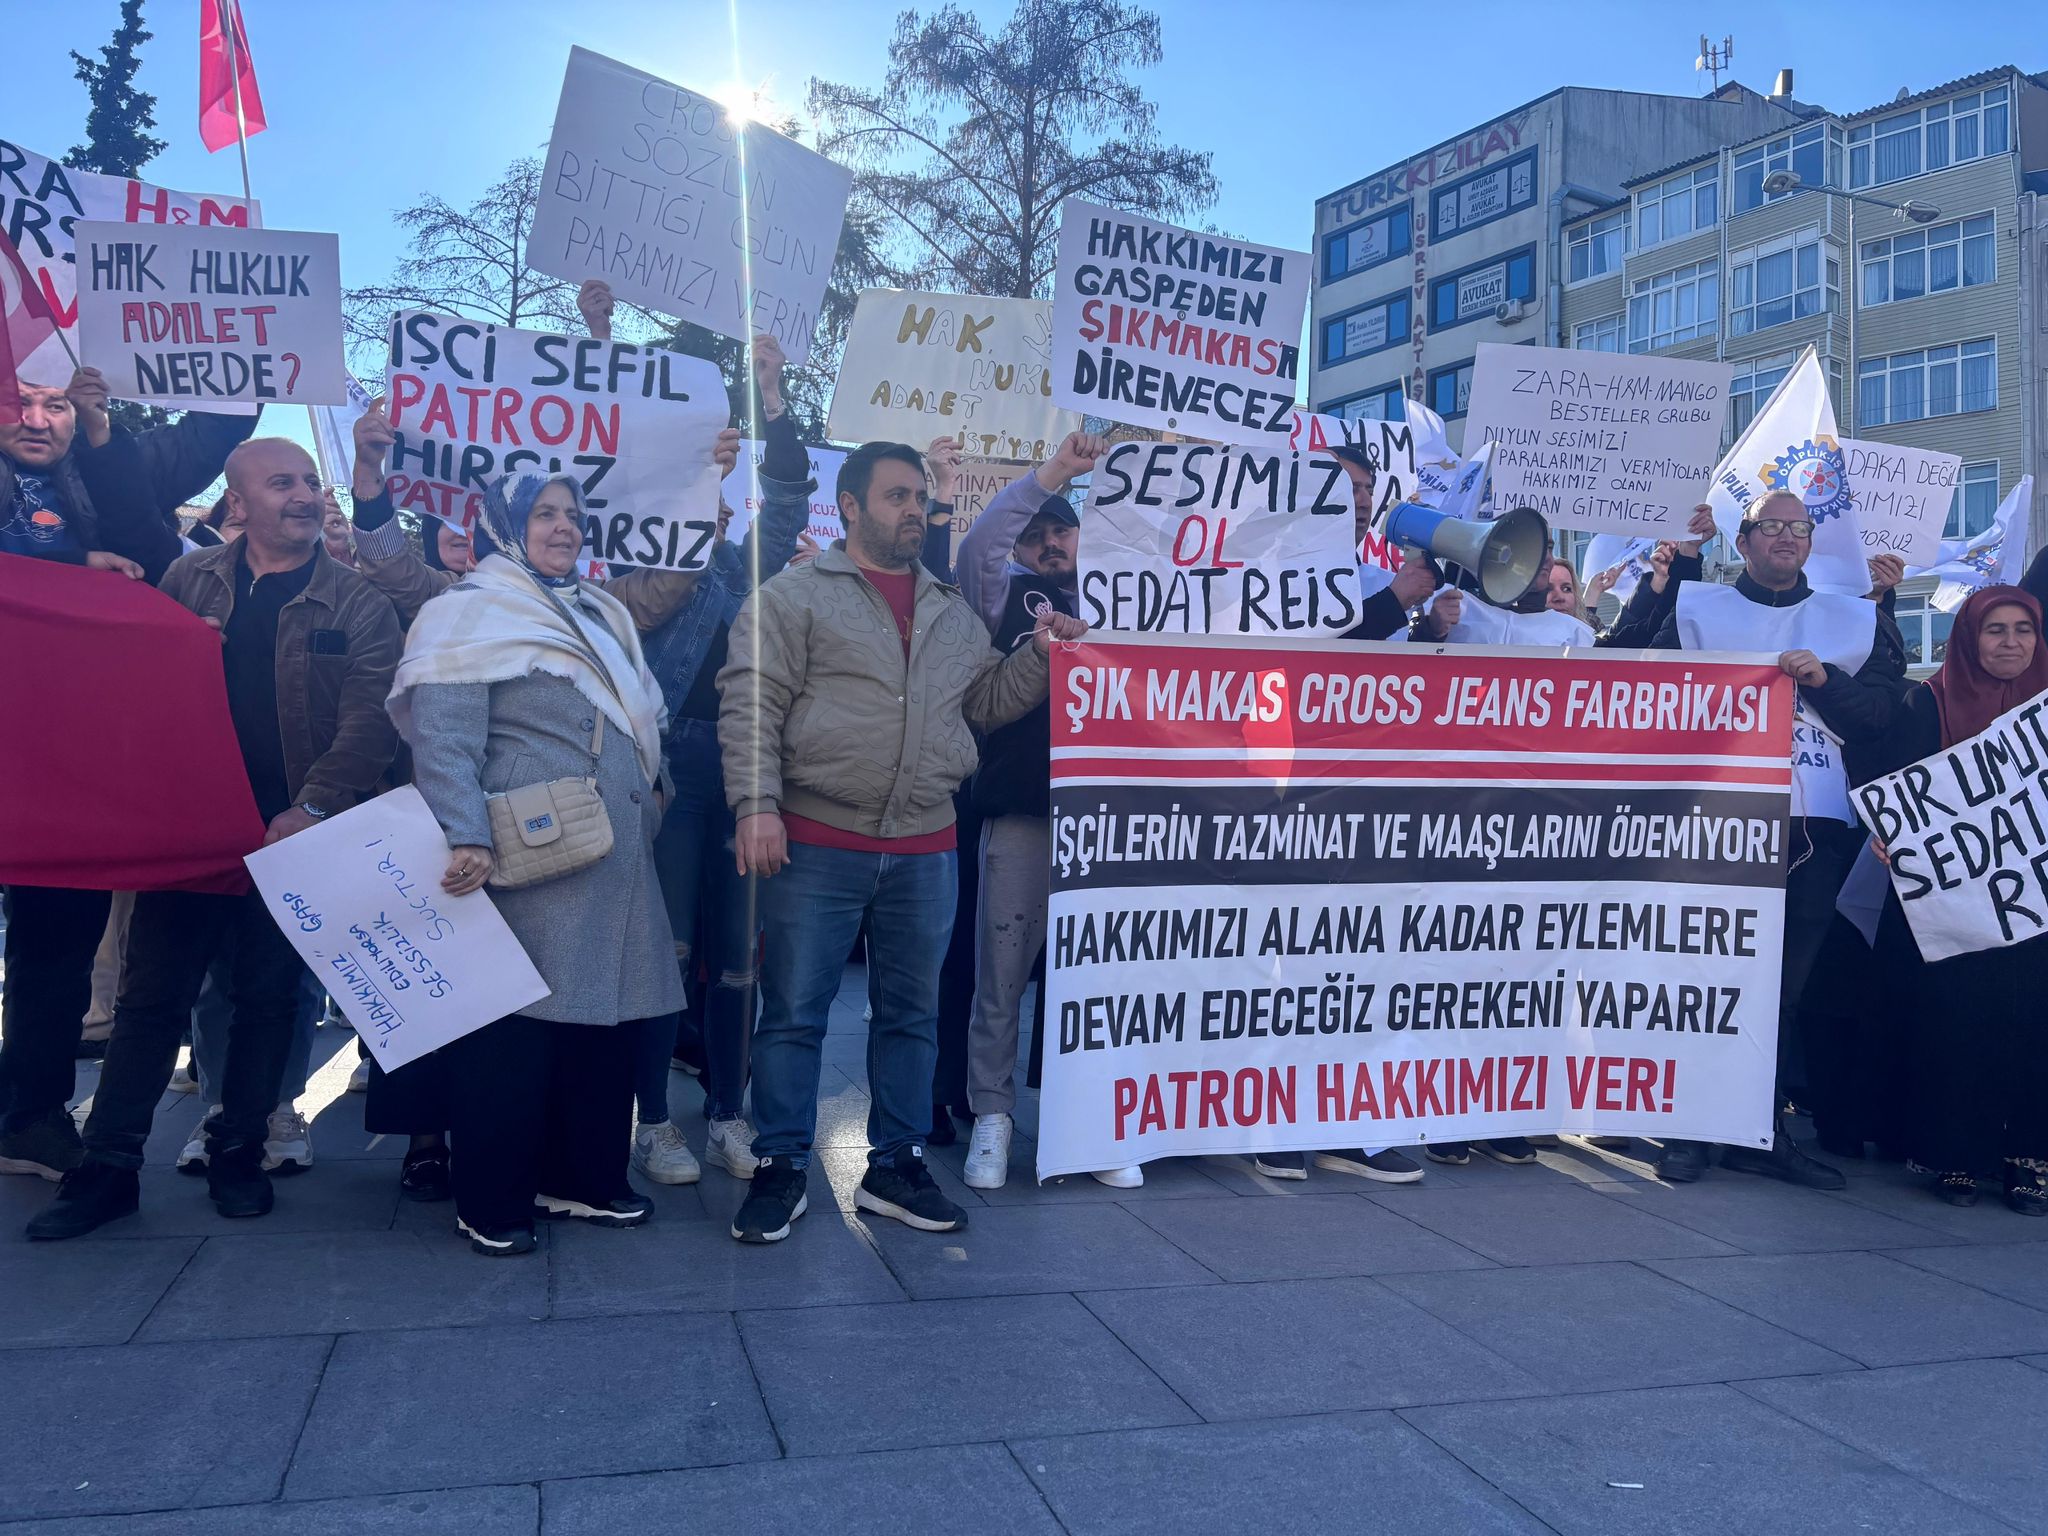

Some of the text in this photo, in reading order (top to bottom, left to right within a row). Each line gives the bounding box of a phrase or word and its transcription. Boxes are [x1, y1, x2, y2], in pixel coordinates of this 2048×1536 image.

[1470, 196, 1496, 213] AVUKAT
[1471, 174, 1496, 191] AVUKAT
[91, 243, 310, 297] HAK HUKUK
[565, 217, 717, 309] PARAMIZI
[731, 216, 816, 275] GÜN
[1088, 218, 1284, 284] HAKKIMIZI
[1074, 264, 1267, 327] GASPEDEN
[1462, 278, 1502, 305] AVUKAT
[122, 302, 277, 345] ADALET
[135, 352, 301, 398] NERDE?
[531, 336, 689, 402] SEFİL
[870, 380, 982, 418] ADALET
[1073, 347, 1296, 432] DİRENECEZ
[389, 374, 620, 455] PATRON
[1483, 425, 1628, 452] DUYUN SESİMİZİ
[1550, 400, 1711, 425] BESTELLER GRUBU
[1095, 444, 1348, 515] SESİMİZ
[1499, 449, 1710, 480] PARALARIMIZI VERMİYOLAR
[1522, 470, 1652, 493] HAKKIMIZ OLANI
[1848, 449, 1905, 484] DAKA
[1173, 515, 1245, 568] OL
[1082, 568, 1355, 634] SEDAT REİS
[1065, 666, 1770, 733] ŞIK MAKAS CROSS JEANS FARBRİKASI
[1860, 765, 1958, 846] BİR
[1051, 803, 1781, 879] İŞÇİLERİN TAZMİNAT VE MAAŞLARINI ÖDEMİYOR!
[1890, 787, 2046, 901] SEDAT
[283, 892, 322, 933] GASP
[1054, 902, 1758, 970] HAKKIMIZI ALANA KADAR EYLEMLERE
[1059, 969, 1741, 1055] DEVAM EDECEĞİZ GEREKENİ YAPARIZ
[1113, 1055, 1677, 1141] PATRON HAKKIMIZI VER!
